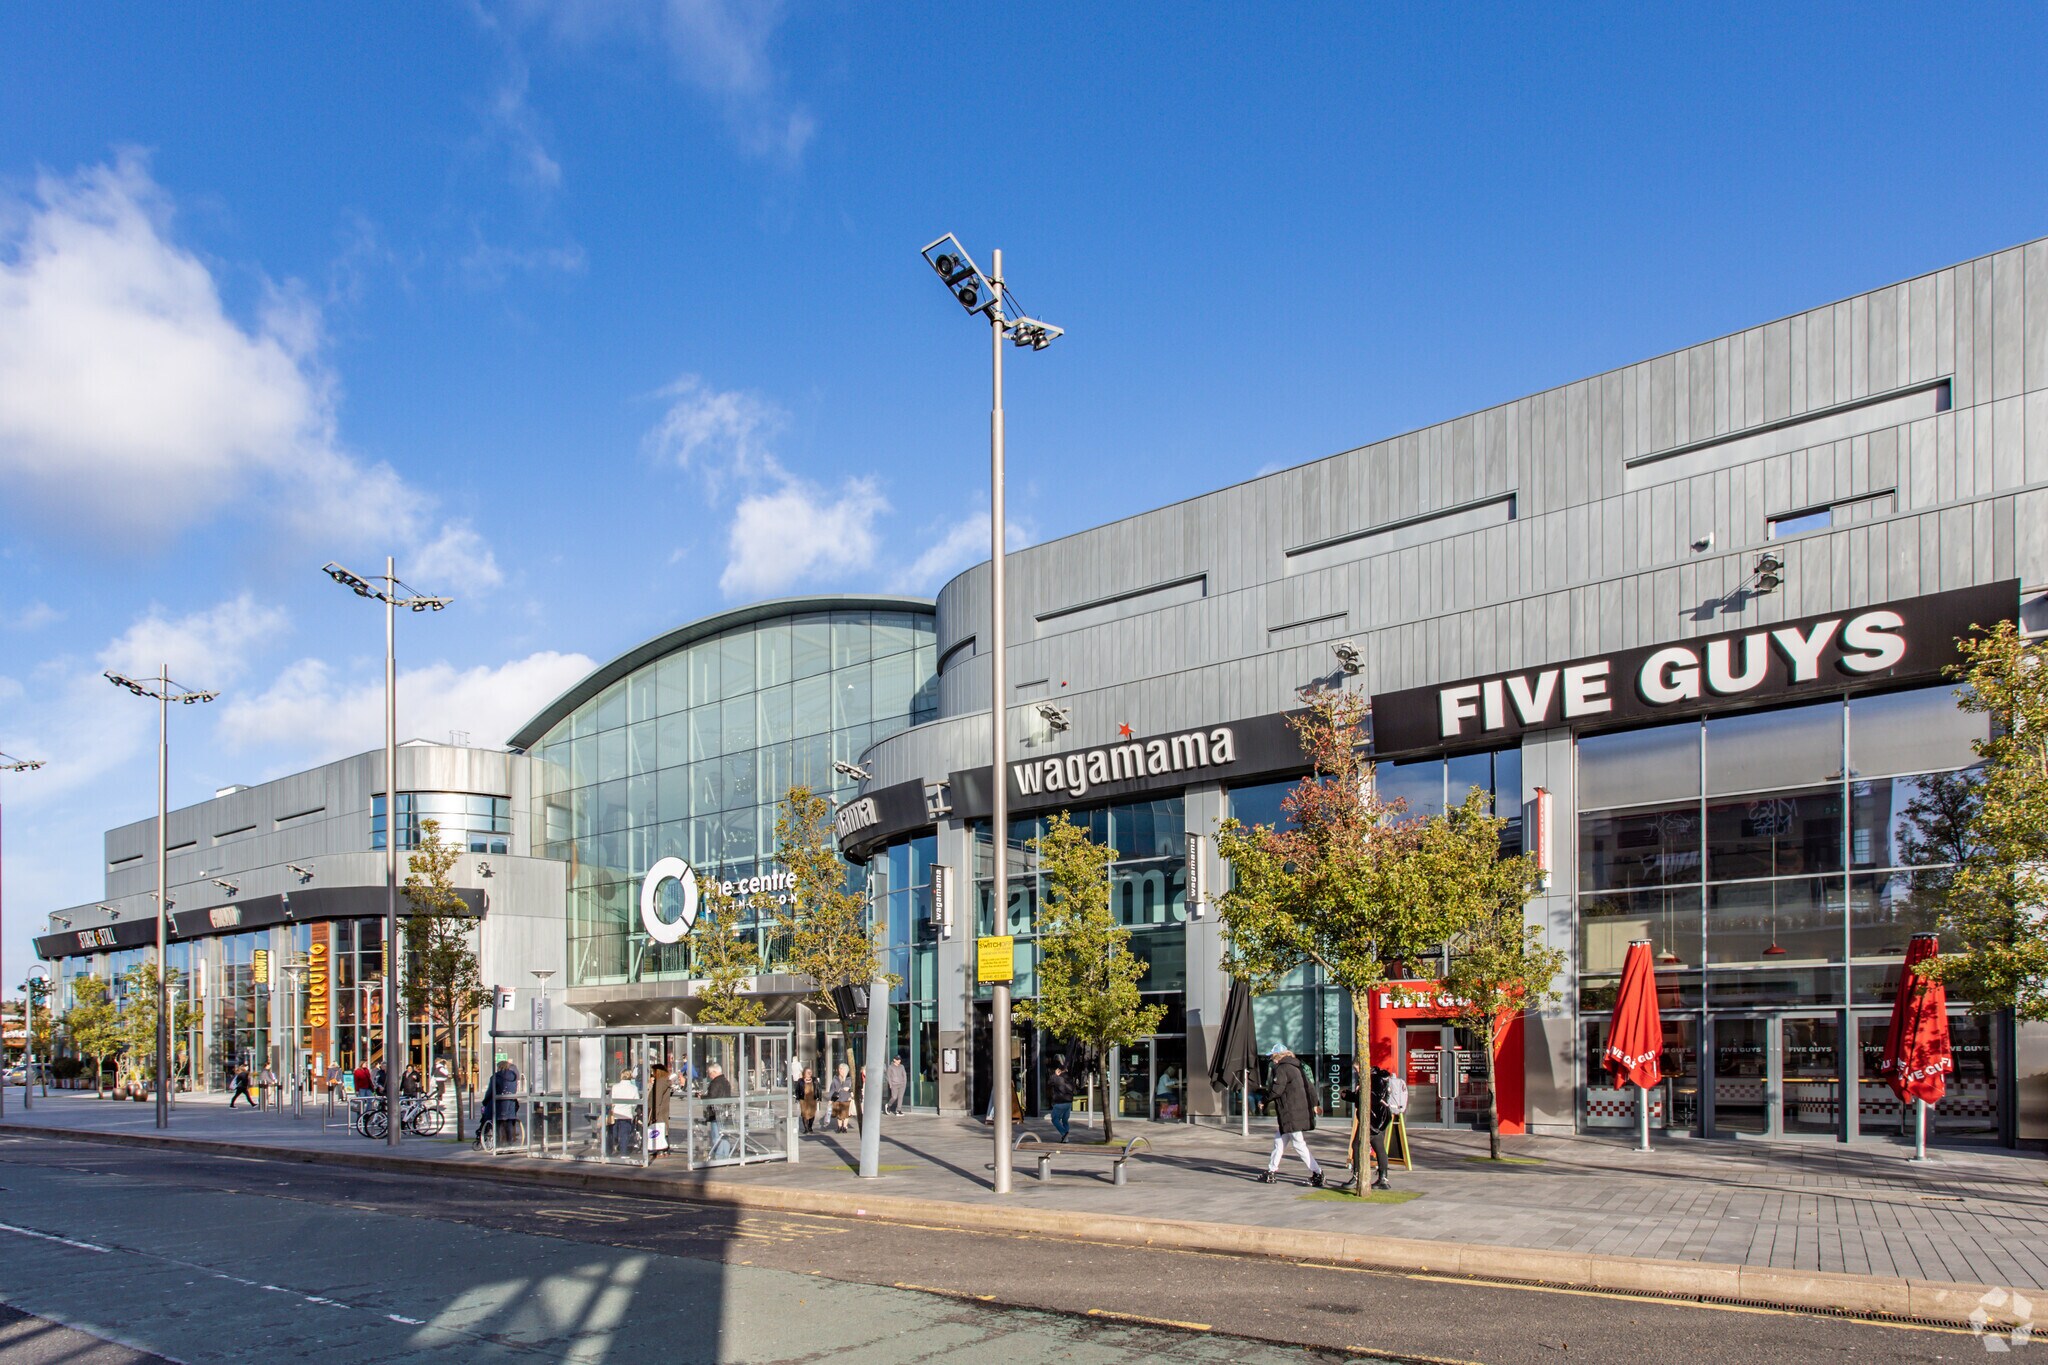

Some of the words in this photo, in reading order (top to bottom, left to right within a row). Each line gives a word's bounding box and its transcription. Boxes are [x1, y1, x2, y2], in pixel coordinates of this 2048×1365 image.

[1440, 661, 1612, 737] FIVE
[1640, 611, 1907, 704] GUYS
[1013, 727, 1236, 797] wagamama
[739, 869, 797, 895] centre
[1190, 838, 1198, 897] wagamama
[935, 869, 943, 920] wagamama
[78, 930, 98, 949] STACK
[98, 927, 118, 946] STILL
[255, 950, 268, 982] CHIQUITO
[309, 943, 328, 1028] CHIQUITO
[502, 994, 511, 1008] F
[1329, 1064, 1340, 1108] noodle
